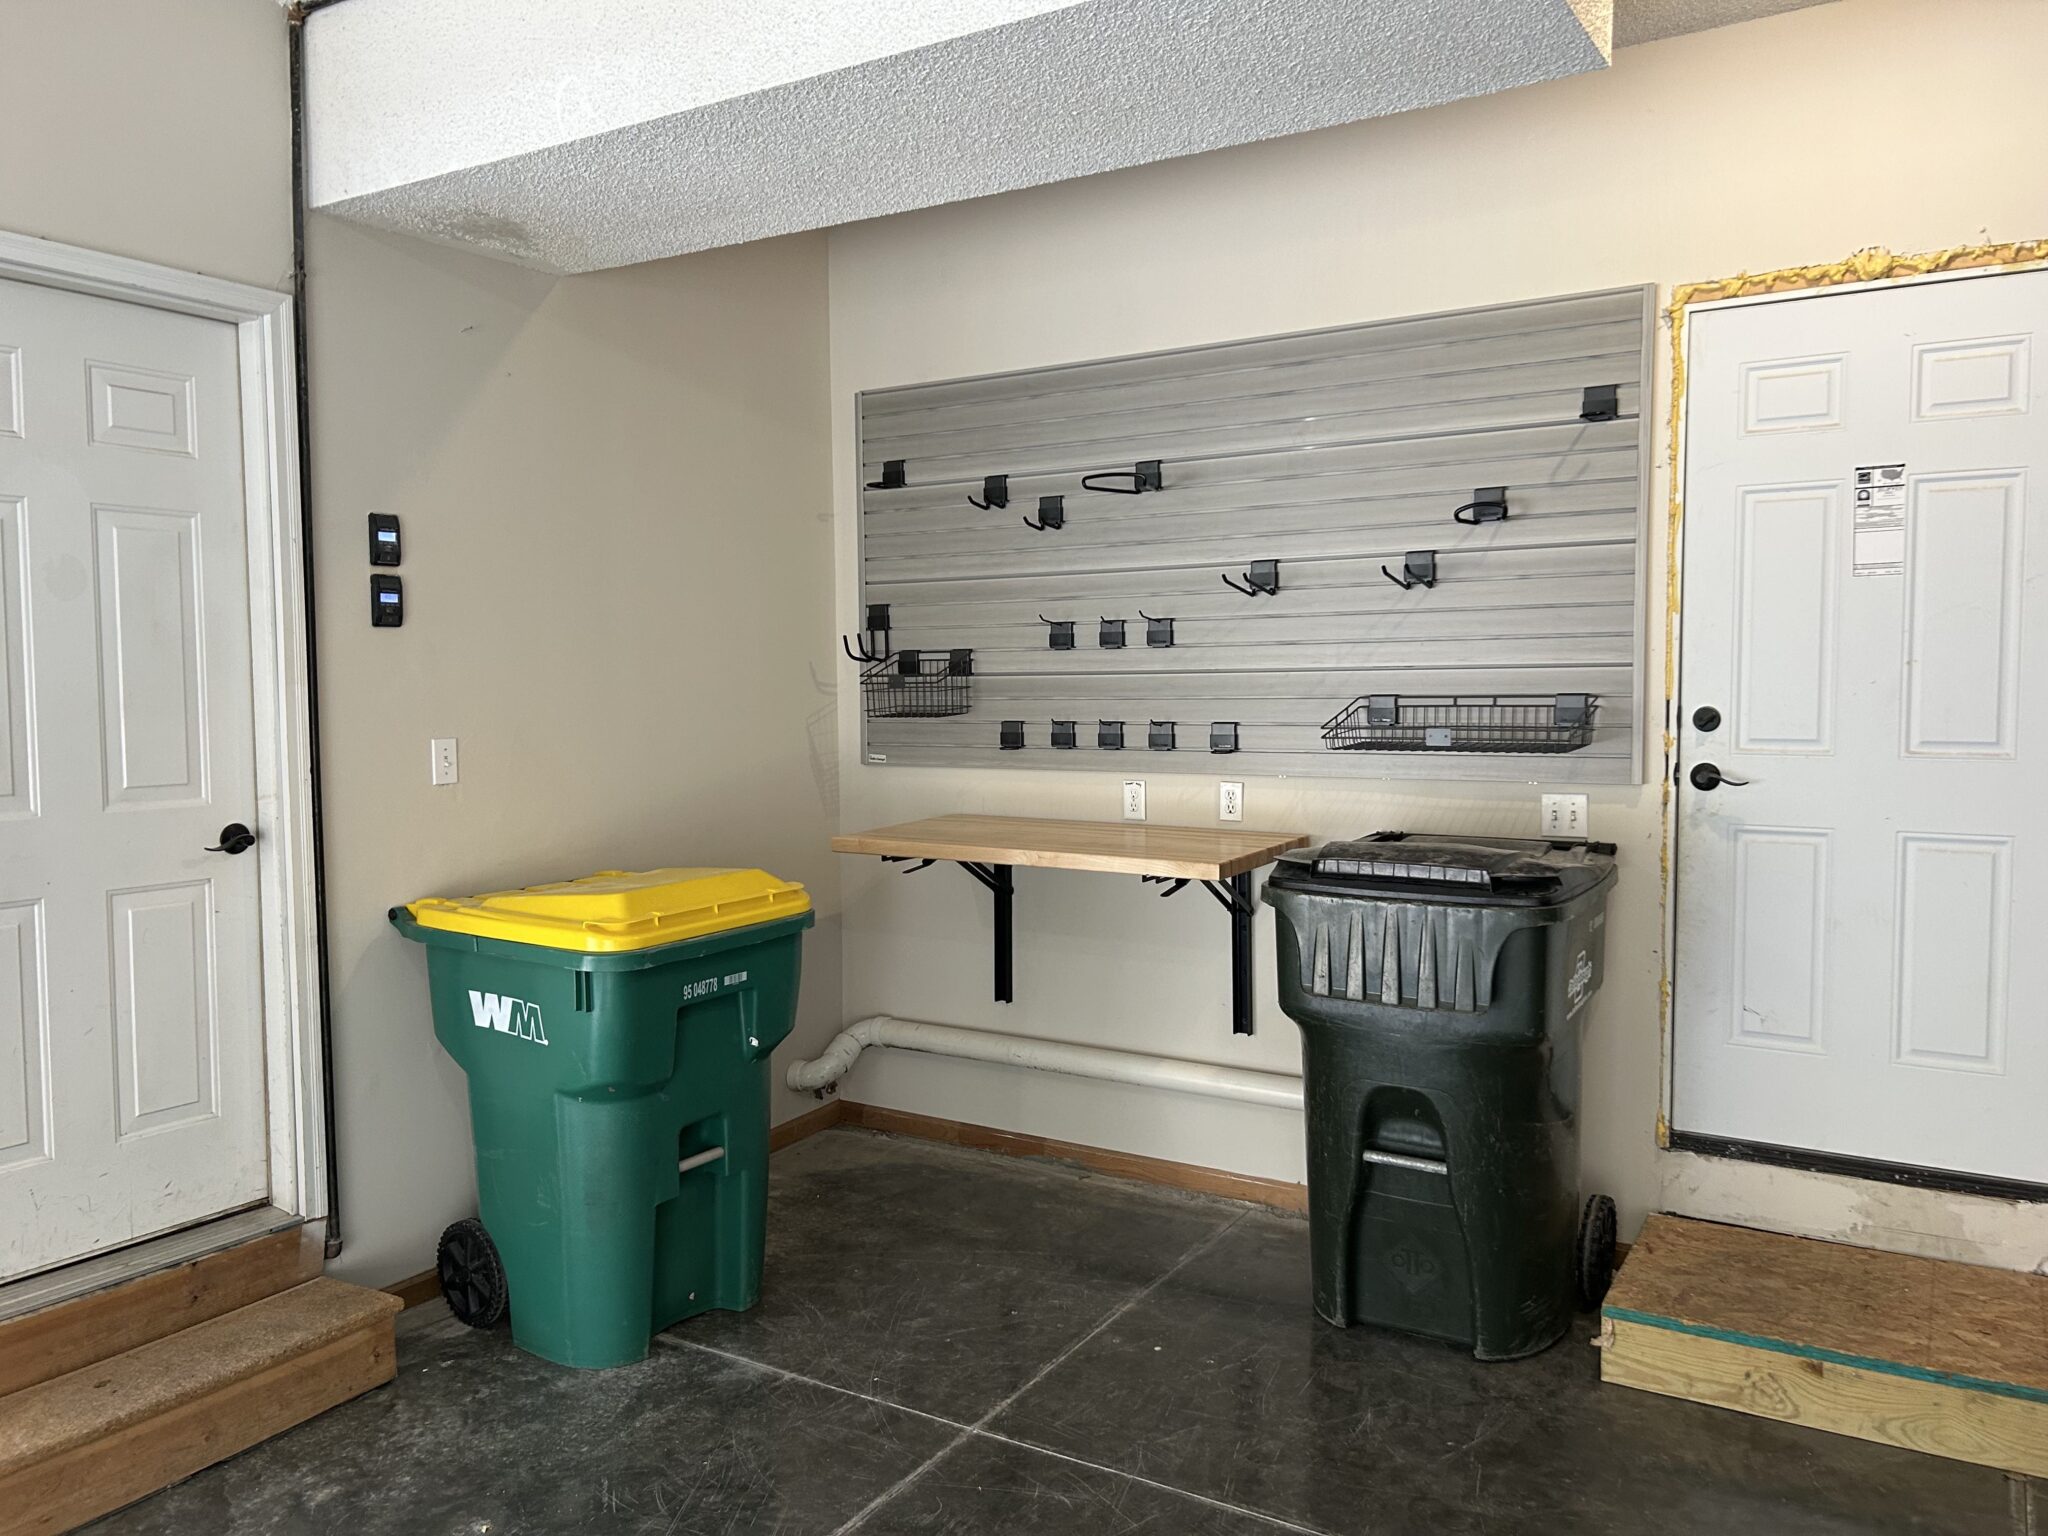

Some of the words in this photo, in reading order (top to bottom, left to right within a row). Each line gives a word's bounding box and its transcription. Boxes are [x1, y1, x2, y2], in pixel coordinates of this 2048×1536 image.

[683, 984, 693, 1000] 95
[693, 977, 718, 997] 048778
[468, 990, 548, 1046] WM
